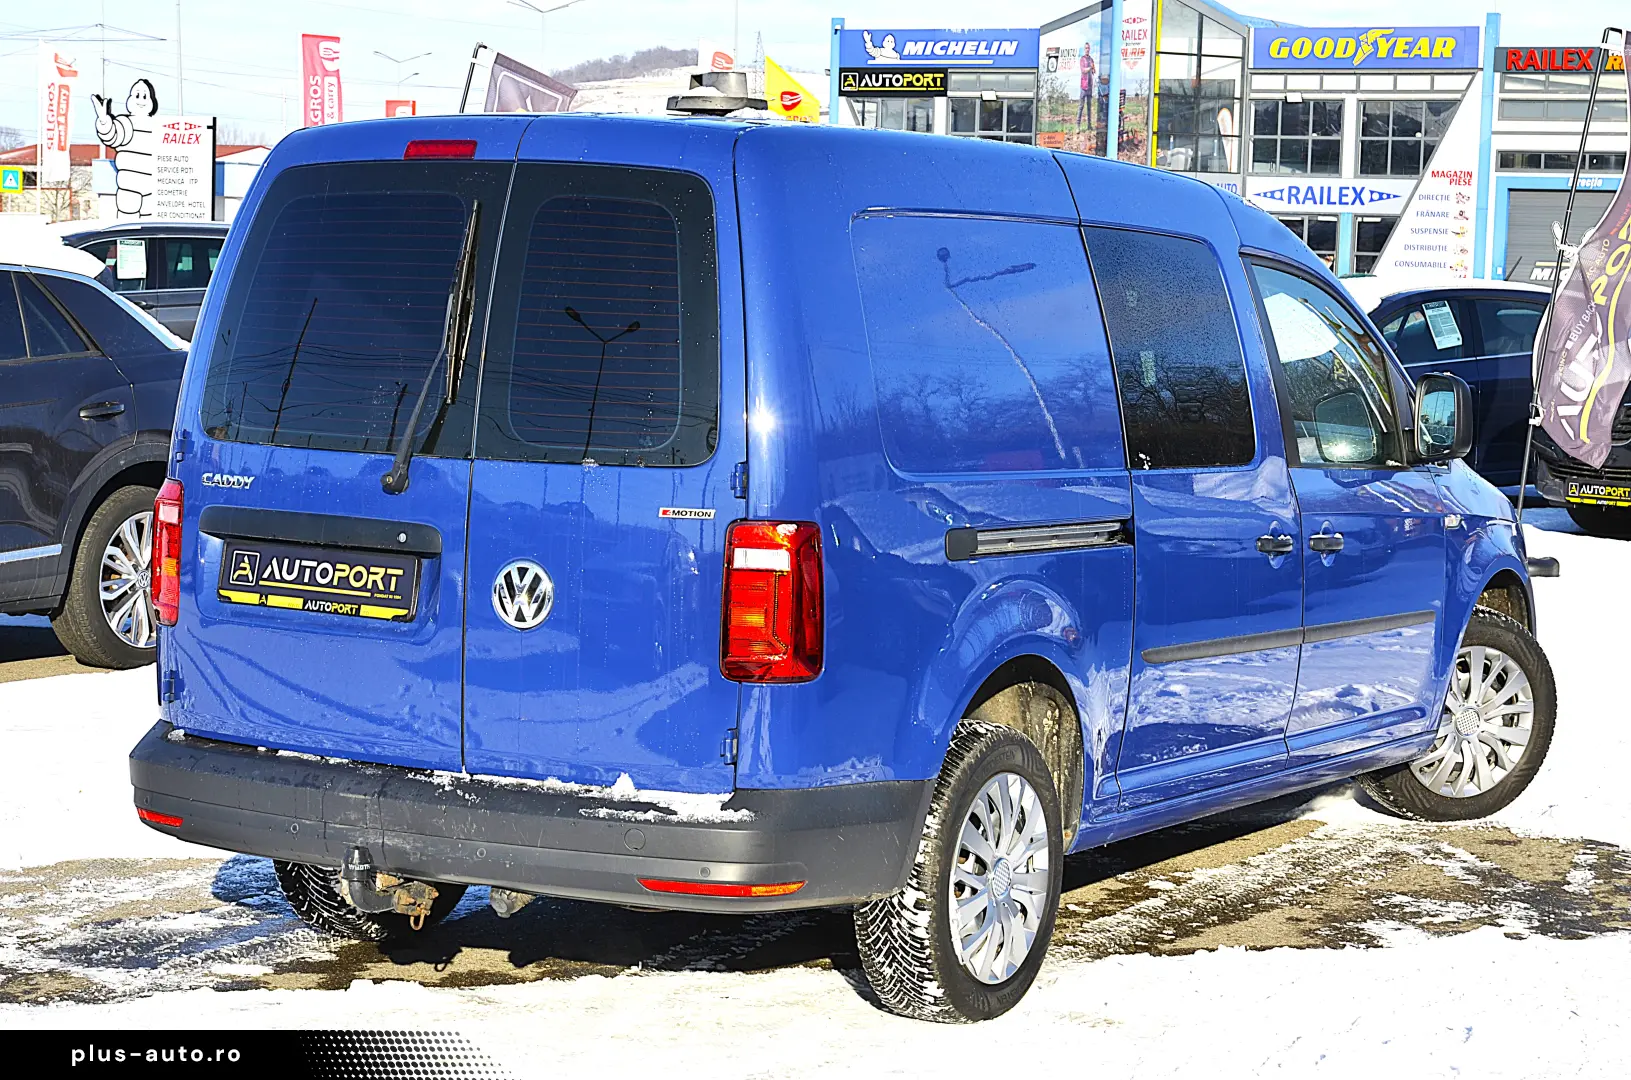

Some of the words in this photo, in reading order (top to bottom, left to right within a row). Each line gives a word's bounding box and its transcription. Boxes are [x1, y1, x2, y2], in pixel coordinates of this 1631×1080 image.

[902, 41, 1018, 56] MICHELIN
[1506, 48, 1594, 70] RAILEX
[860, 73, 944, 86] AUTOPORT
[162, 133, 202, 144] RAILEX
[1431, 170, 1472, 178] MAGAZIN
[1287, 186, 1366, 206] RAILEX
[1394, 260, 1447, 268] CONSUMABILE
[1569, 321, 1586, 342] BUY
[1582, 300, 1597, 322] BACK
[202, 472, 255, 489] CADDY
[1580, 485, 1631, 497] AUTOPORT
[262, 556, 404, 592] AUTOPORT
[304, 600, 358, 614] AUTOPORT
